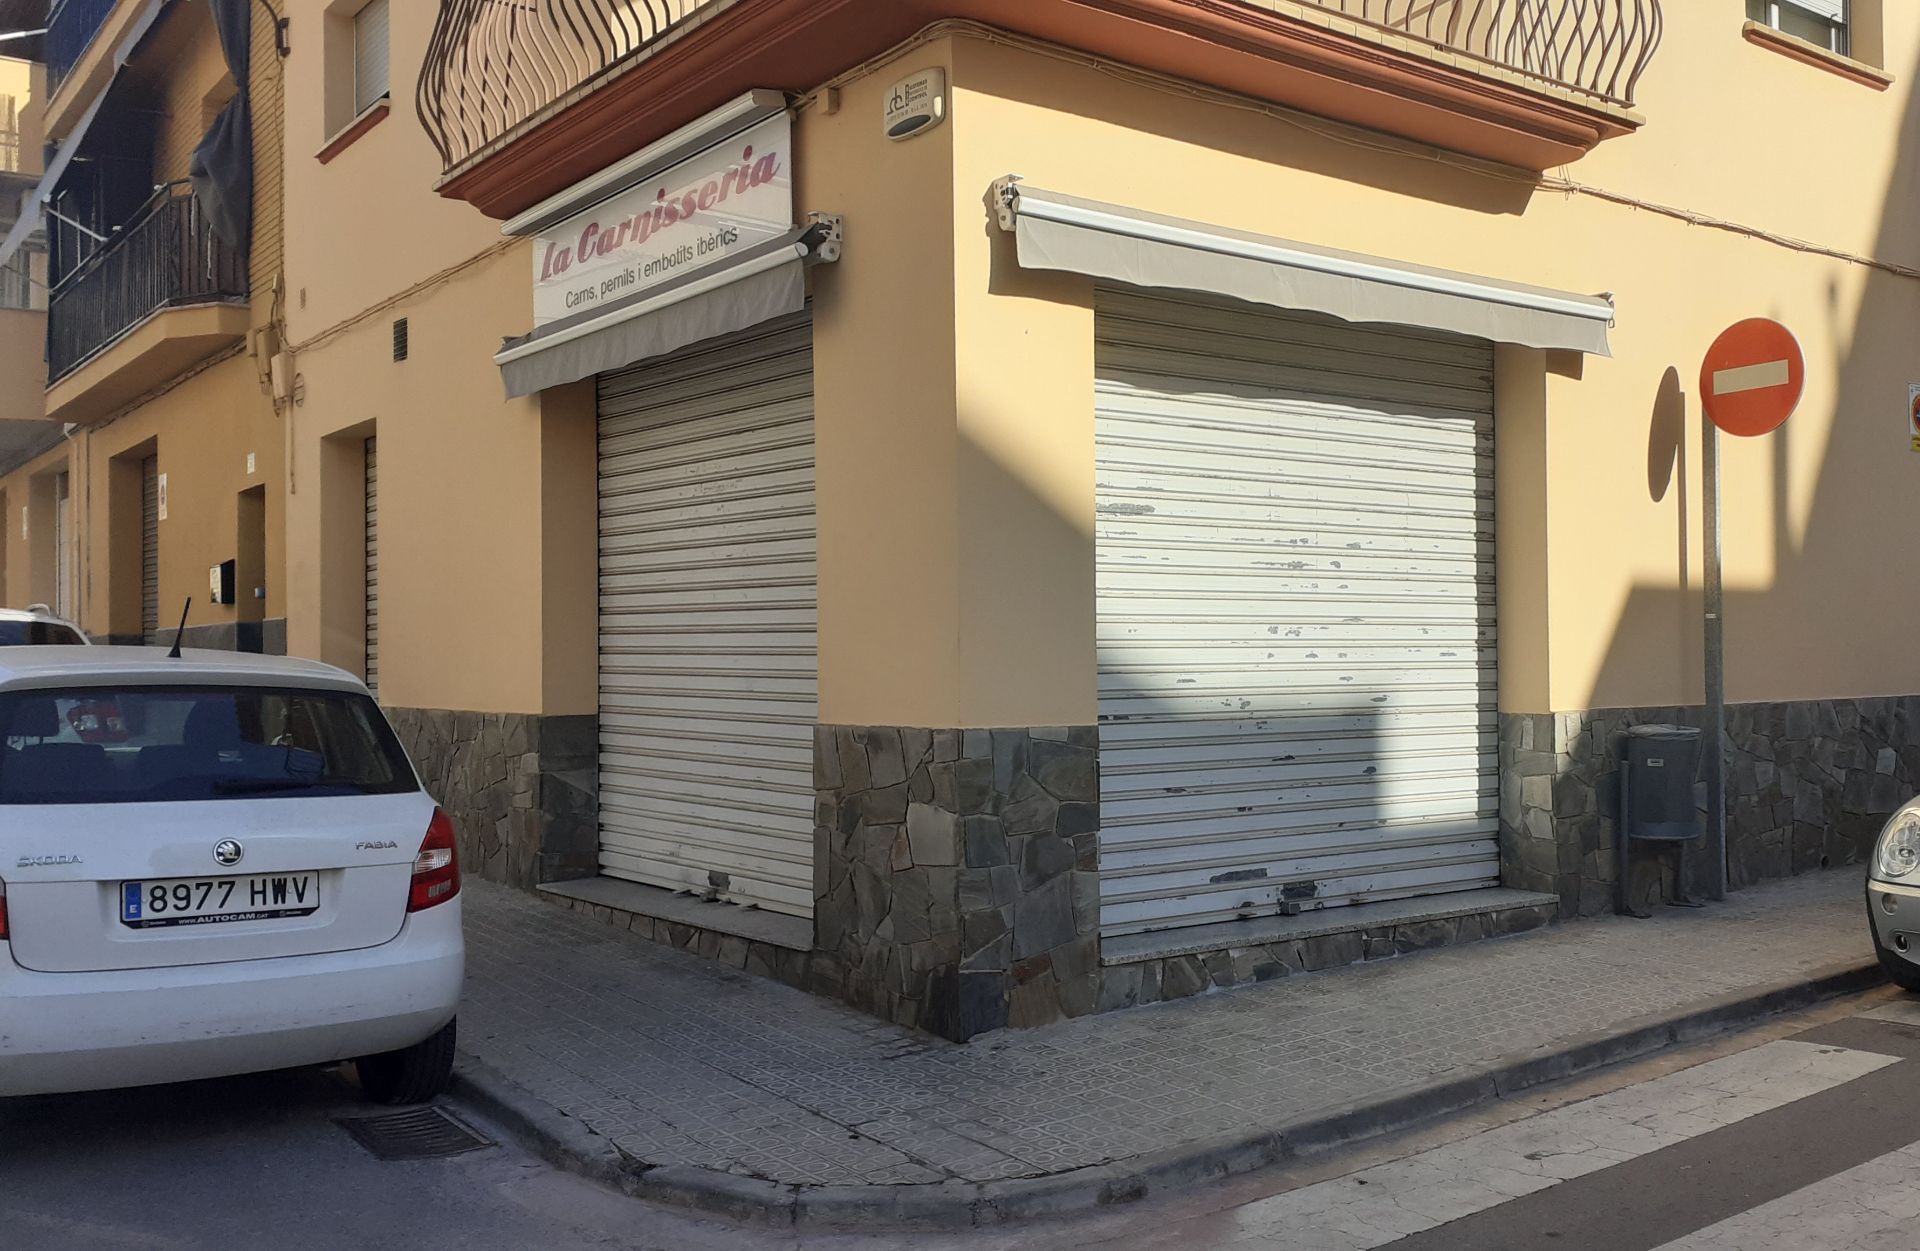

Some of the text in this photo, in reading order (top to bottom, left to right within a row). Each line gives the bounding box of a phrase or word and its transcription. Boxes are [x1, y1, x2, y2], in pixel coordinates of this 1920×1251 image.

[577, 145, 781, 264] Carnisseria
[600, 267, 635, 300] pernils
[638, 263, 642, 280] i
[644, 245, 694, 278] embotits
[696, 226, 738, 256] ibèrics
[354, 840, 399, 850] FABIA
[128, 904, 138, 914] E
[149, 876, 309, 913] 8977 HWV
